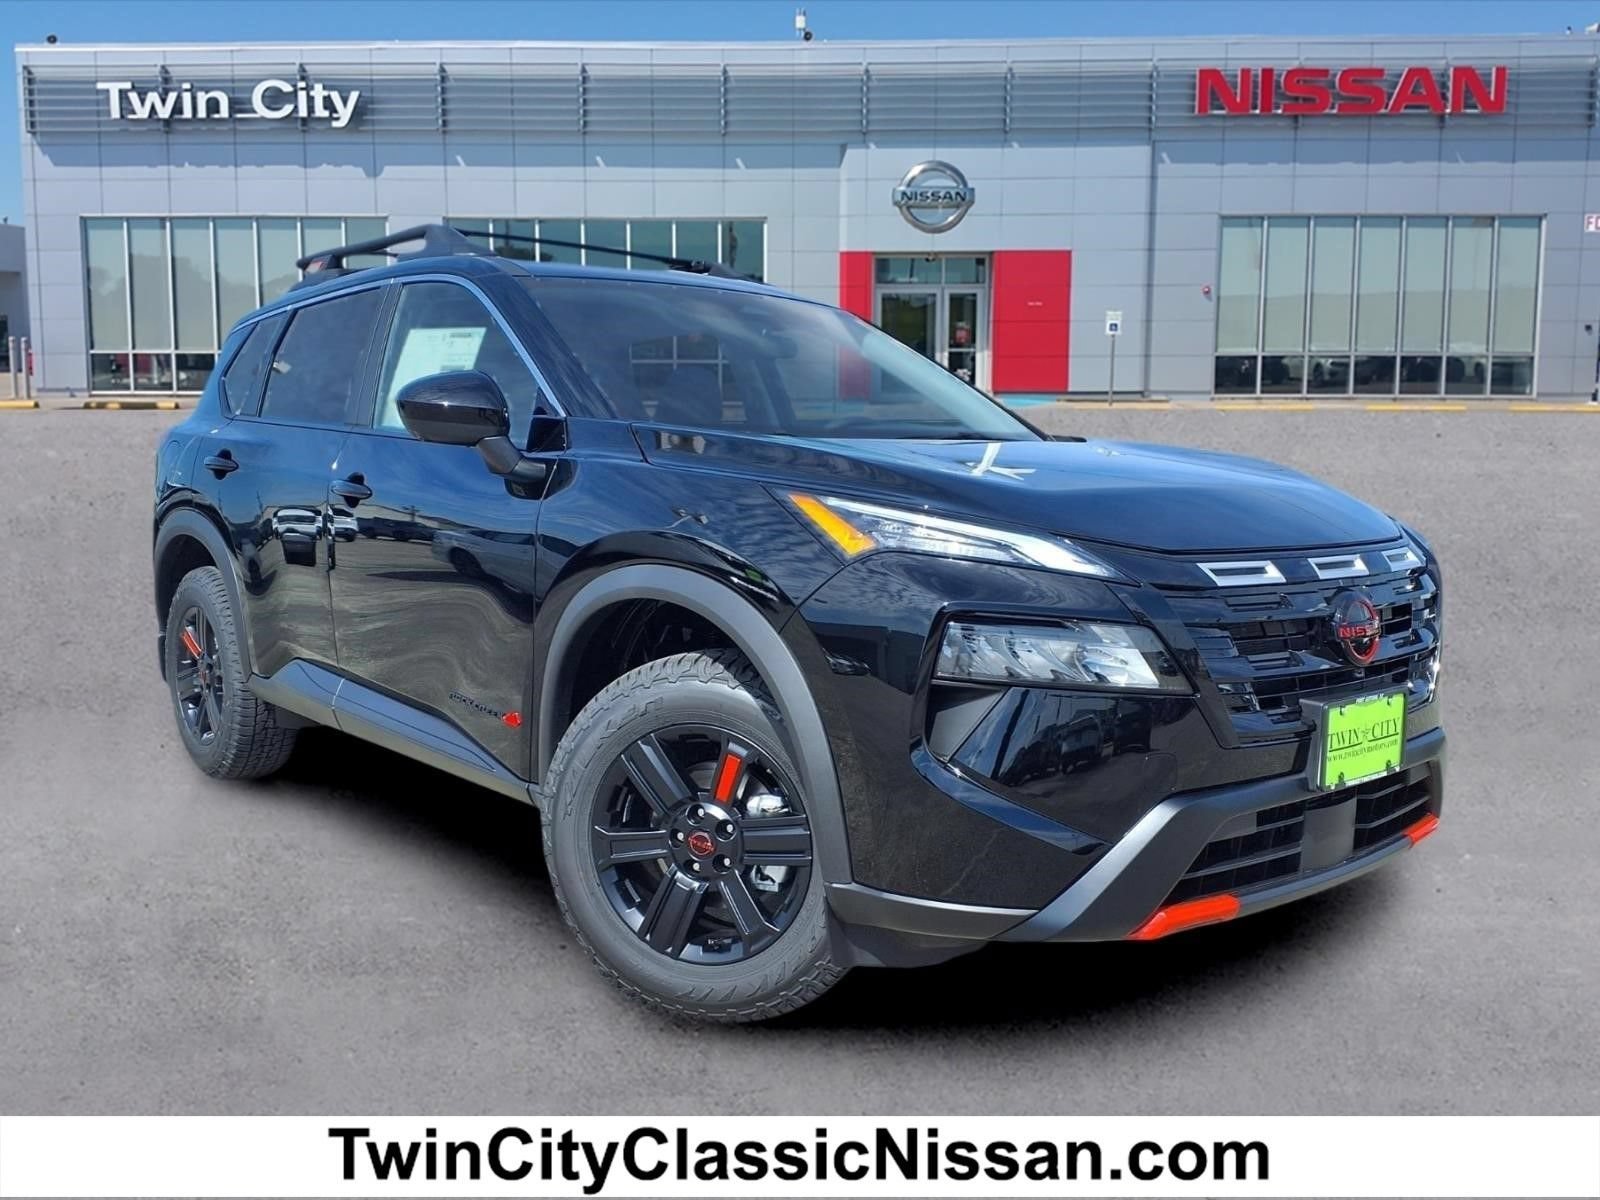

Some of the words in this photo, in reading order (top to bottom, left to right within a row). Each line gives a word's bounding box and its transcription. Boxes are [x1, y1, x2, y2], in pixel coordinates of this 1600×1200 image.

[96, 81, 231, 119] Twin
[251, 79, 361, 128] City
[1194, 65, 1508, 115] NISSAN
[900, 190, 968, 203] NISSAN
[1328, 726, 1361, 750] TWIN
[1371, 717, 1400, 739] CITY
